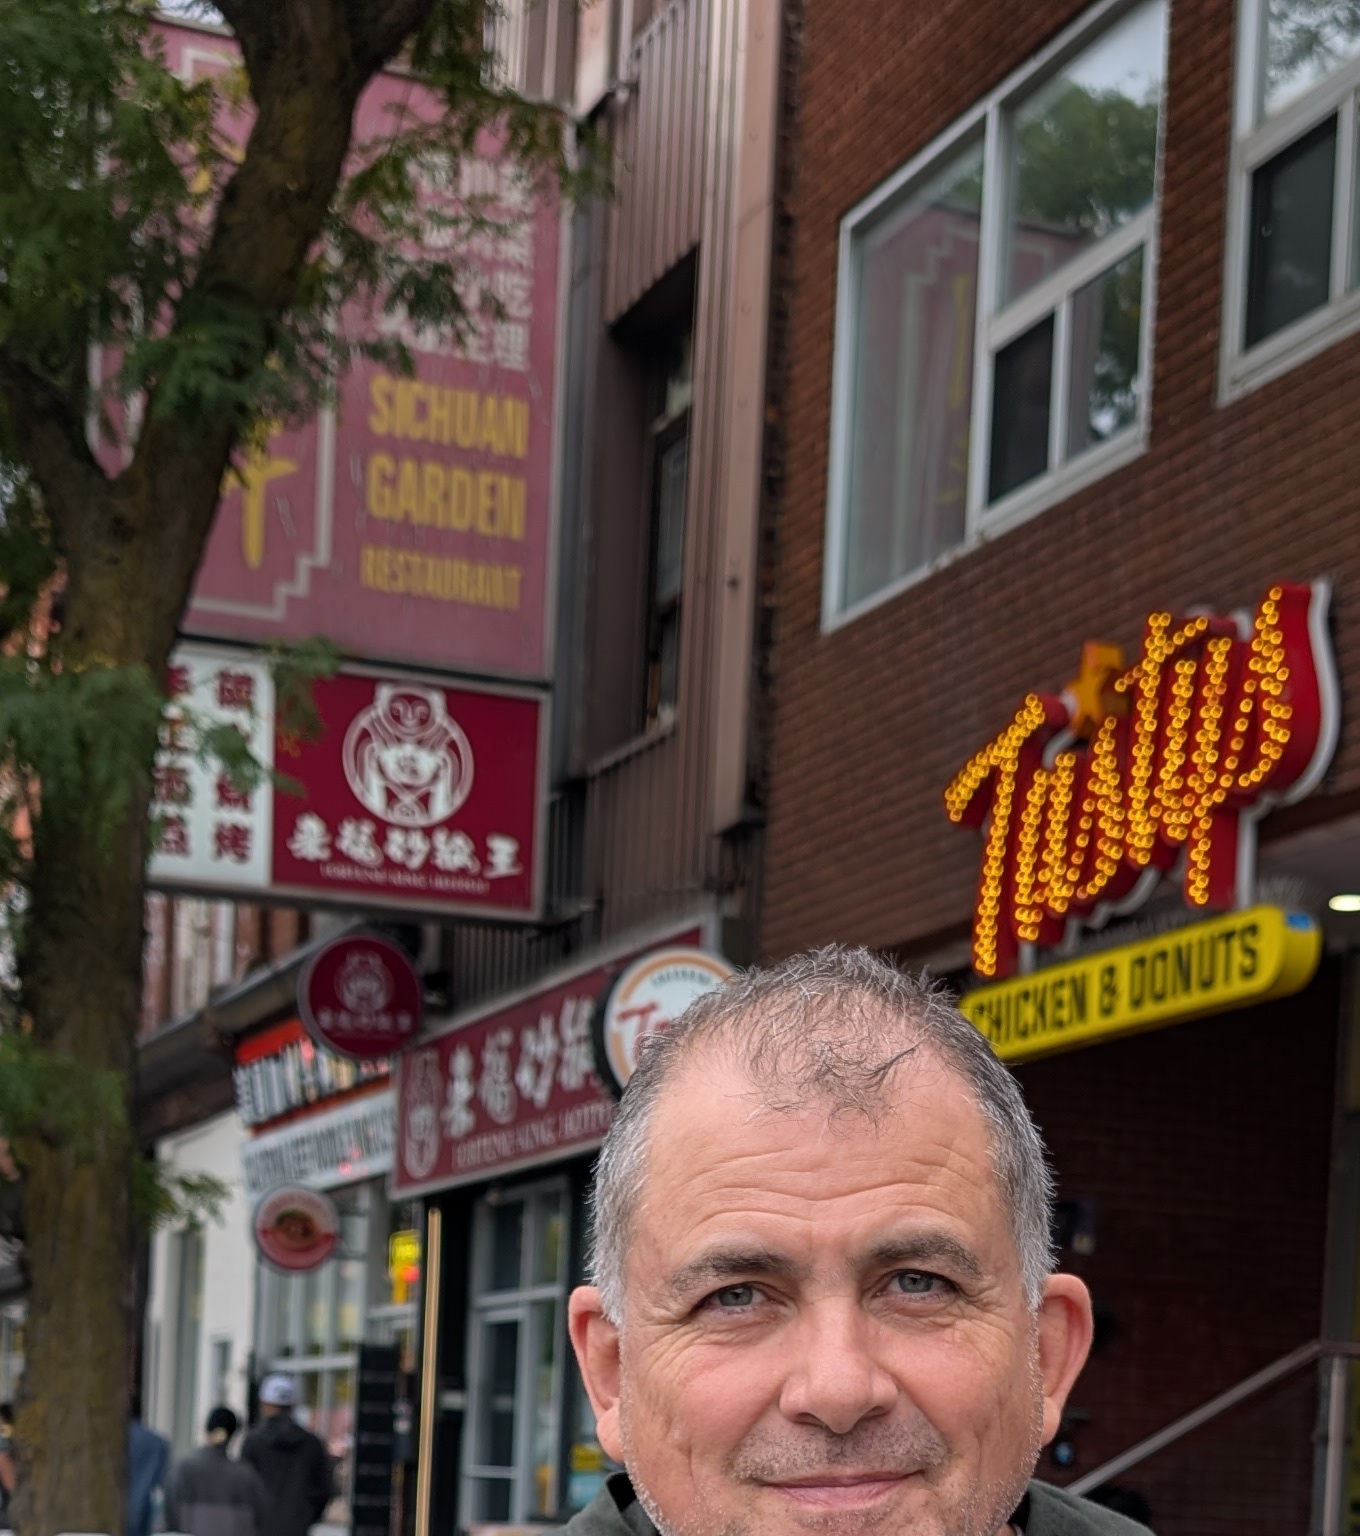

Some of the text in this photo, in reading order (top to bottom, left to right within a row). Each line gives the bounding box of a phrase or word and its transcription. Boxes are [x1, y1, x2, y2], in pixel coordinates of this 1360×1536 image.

[368, 375, 529, 457] SICHUAN
[367, 452, 526, 541] GARDEN
[360, 546, 524, 611] RESTAURANT
[972, 924, 1259, 1043] CHICKEN & DONUTS
